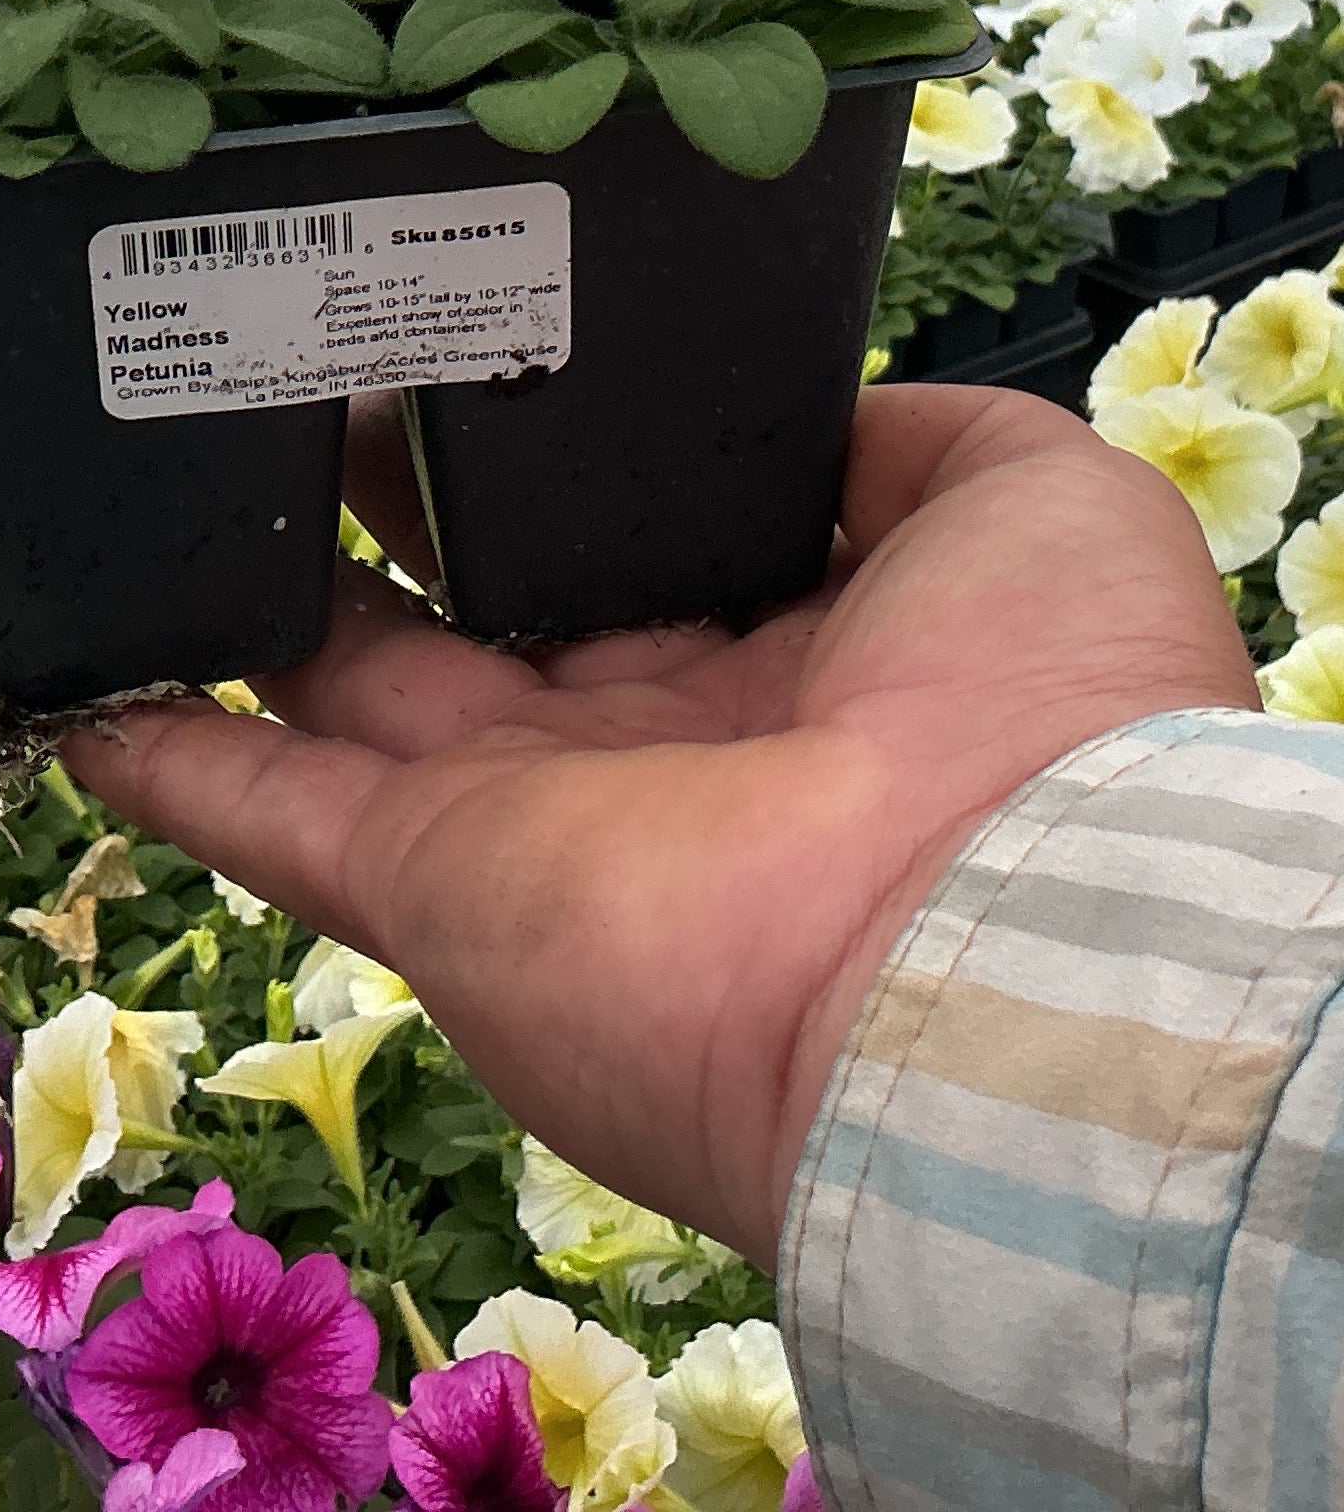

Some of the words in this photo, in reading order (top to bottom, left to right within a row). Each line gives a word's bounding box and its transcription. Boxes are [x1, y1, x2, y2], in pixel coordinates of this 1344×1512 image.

[324, 269, 355, 282] Sun
[324, 282, 371, 299] Space
[325, 301, 372, 317] Grows
[454, 289, 472, 304] by
[527, 282, 561, 294] wide
[104, 302, 188, 324] Yellow
[326, 315, 398, 333] Excellent
[401, 309, 442, 324] show
[446, 305, 462, 318] of
[465, 302, 504, 317] color
[509, 302, 524, 314] in
[107, 330, 230, 355] Madness
[326, 333, 366, 350] beds
[370, 329, 399, 341] and
[403, 320, 487, 338] containers
[110, 358, 212, 385] Petunia
[117, 384, 181, 401] Grown
[187, 379, 212, 395] By
[383, 354, 438, 369] Acres
[245, 390, 266, 404] La
[328, 378, 348, 393] IN
